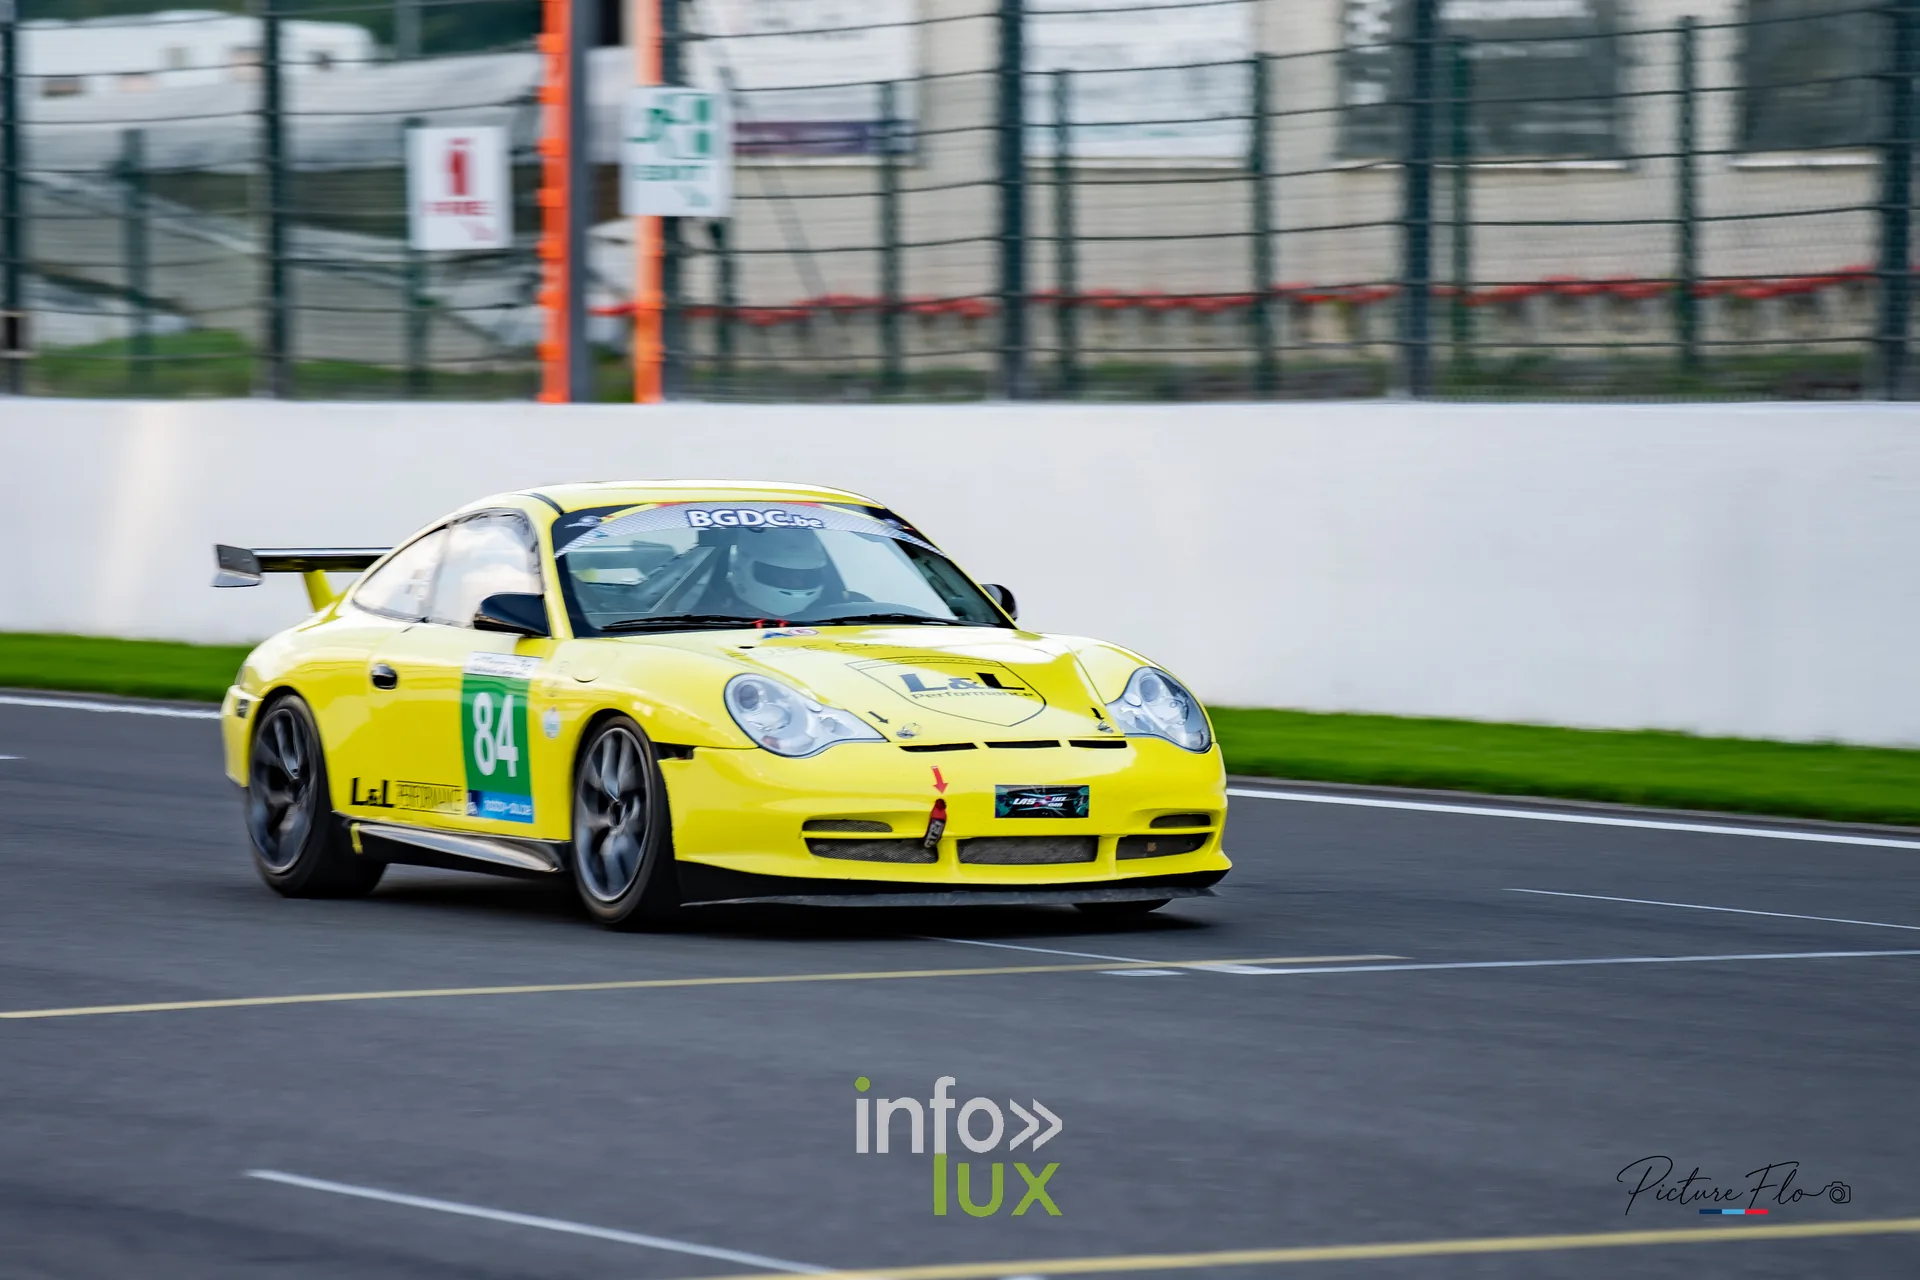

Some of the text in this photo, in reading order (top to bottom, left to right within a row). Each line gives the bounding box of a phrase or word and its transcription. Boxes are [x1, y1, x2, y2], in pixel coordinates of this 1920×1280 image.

[686, 509, 825, 528] BGDC.be
[898, 671, 1026, 693] L&L
[911, 690, 1034, 700] Performance
[472, 691, 519, 778] 84
[349, 776, 396, 808] L&L
